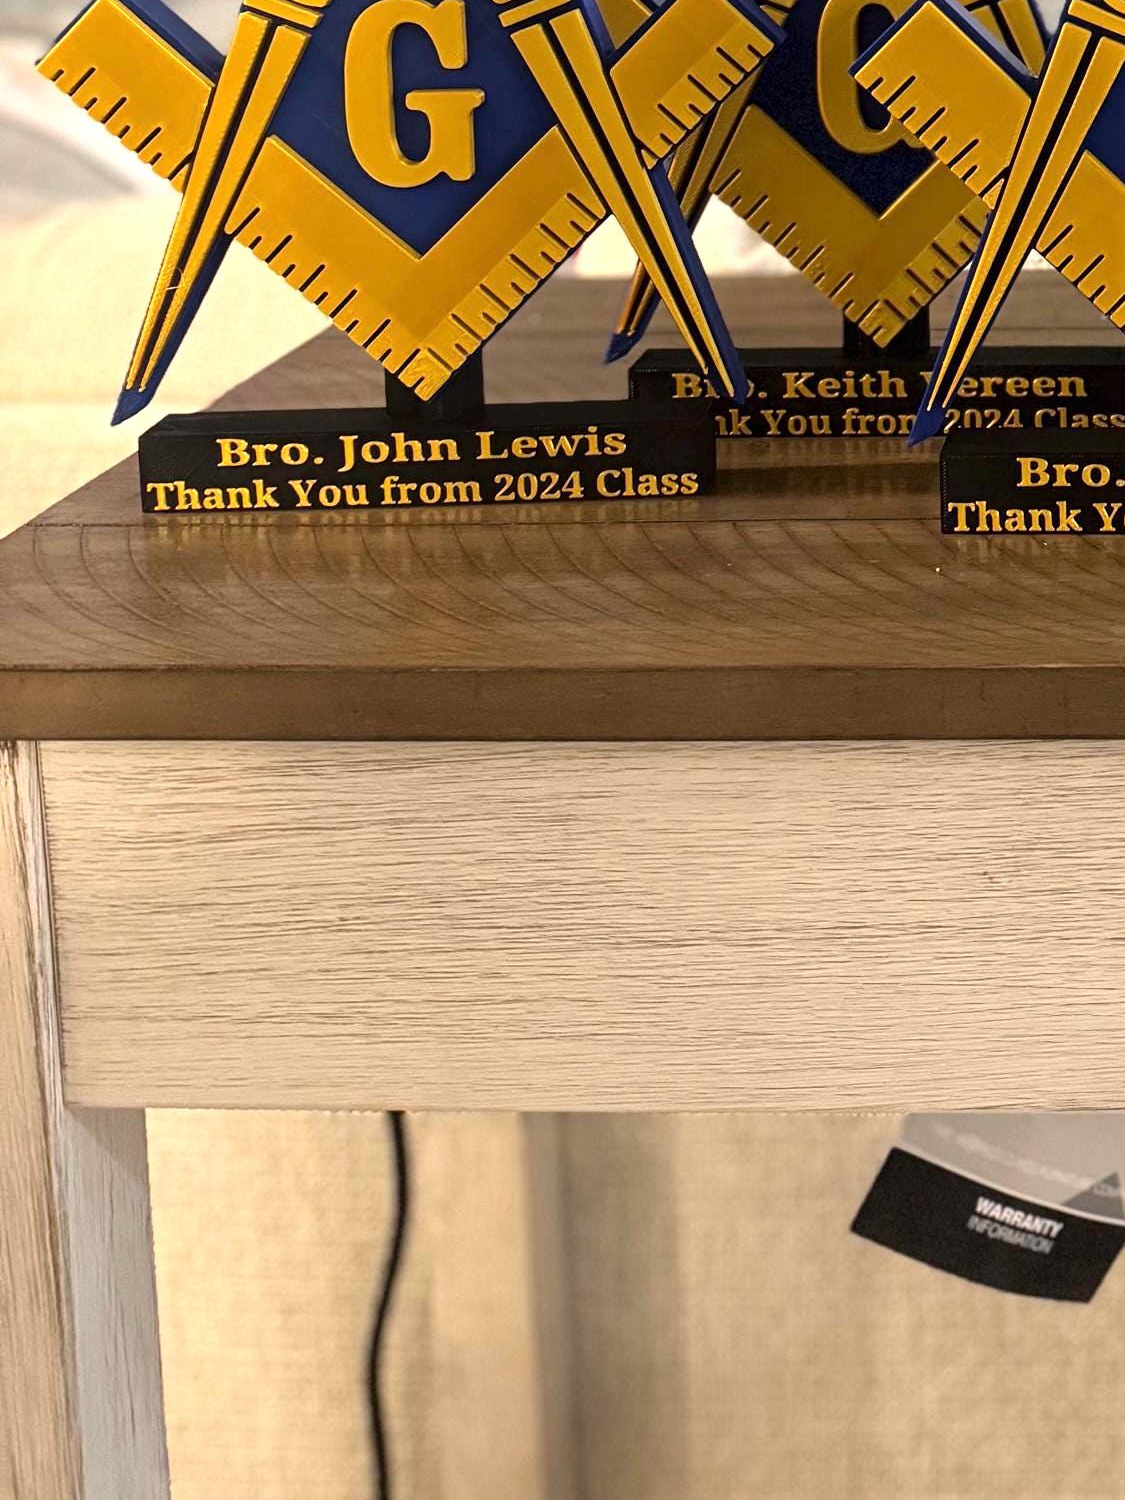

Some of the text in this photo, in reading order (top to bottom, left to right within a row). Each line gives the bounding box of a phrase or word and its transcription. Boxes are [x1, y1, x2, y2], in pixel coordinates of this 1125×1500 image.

[782, 370, 908, 399] Keith
[919, 371, 1088, 398] ereen
[760, 409, 832, 436] You
[943, 408, 1024, 434] 2024
[216, 426, 628, 473] Bro. John Lewis
[146, 466, 700, 512] Thank You from 2024 Class
[947, 501, 1082, 533] Thank
[974, 1196, 1065, 1238] WARRANTY
